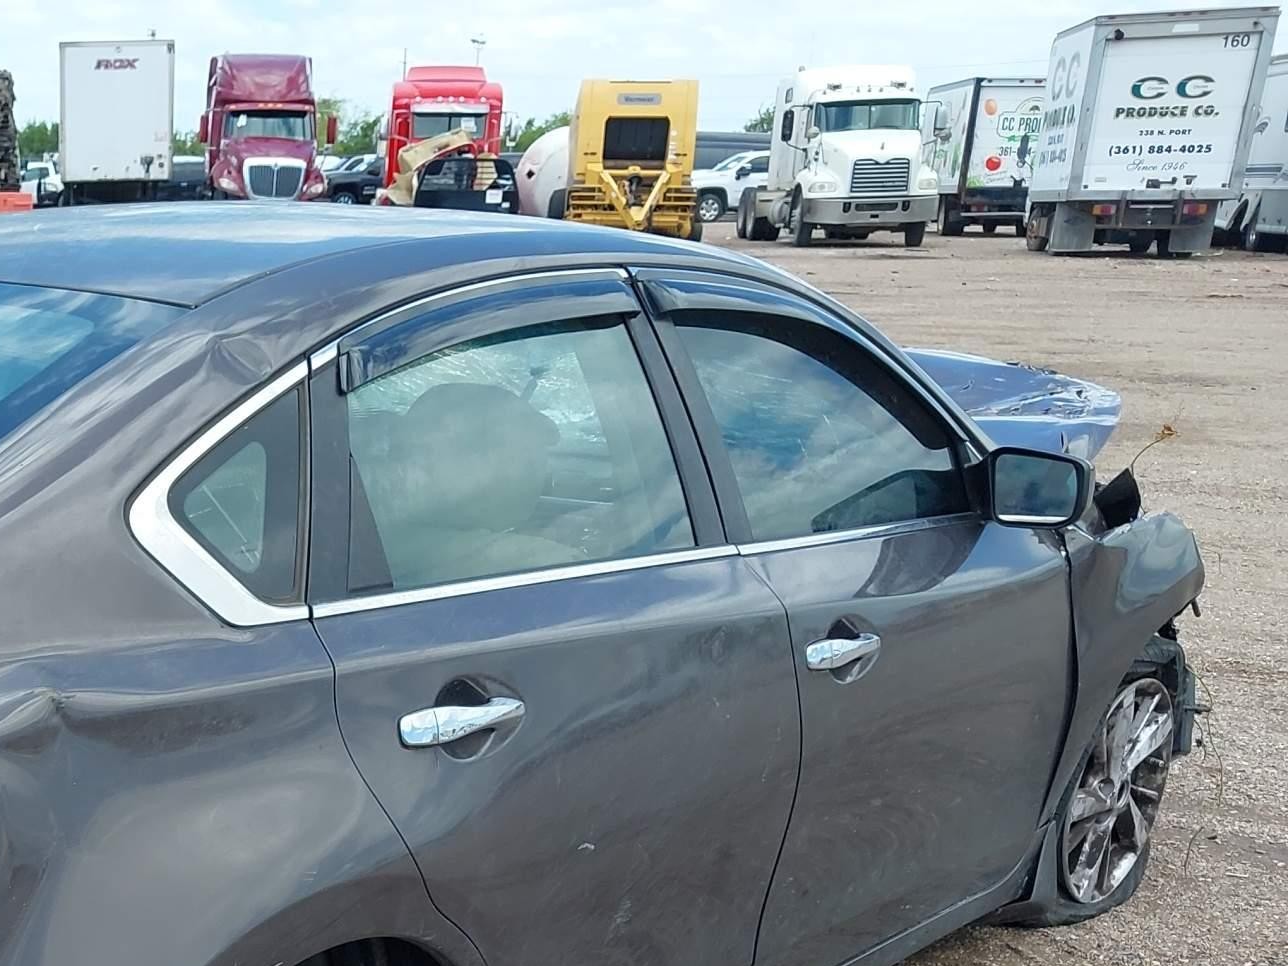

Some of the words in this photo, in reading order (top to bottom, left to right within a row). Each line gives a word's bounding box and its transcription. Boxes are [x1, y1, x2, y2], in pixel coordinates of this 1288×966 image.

[1222, 34, 1250, 48] 160
[1114, 105, 1189, 119] PRODUCE
[1193, 104, 1220, 117] CO.
[1001, 117, 1015, 131] CC
[1109, 145, 1142, 156] (361)
[1148, 144, 1213, 154] 884-4025
[1126, 158, 1158, 172] Since
